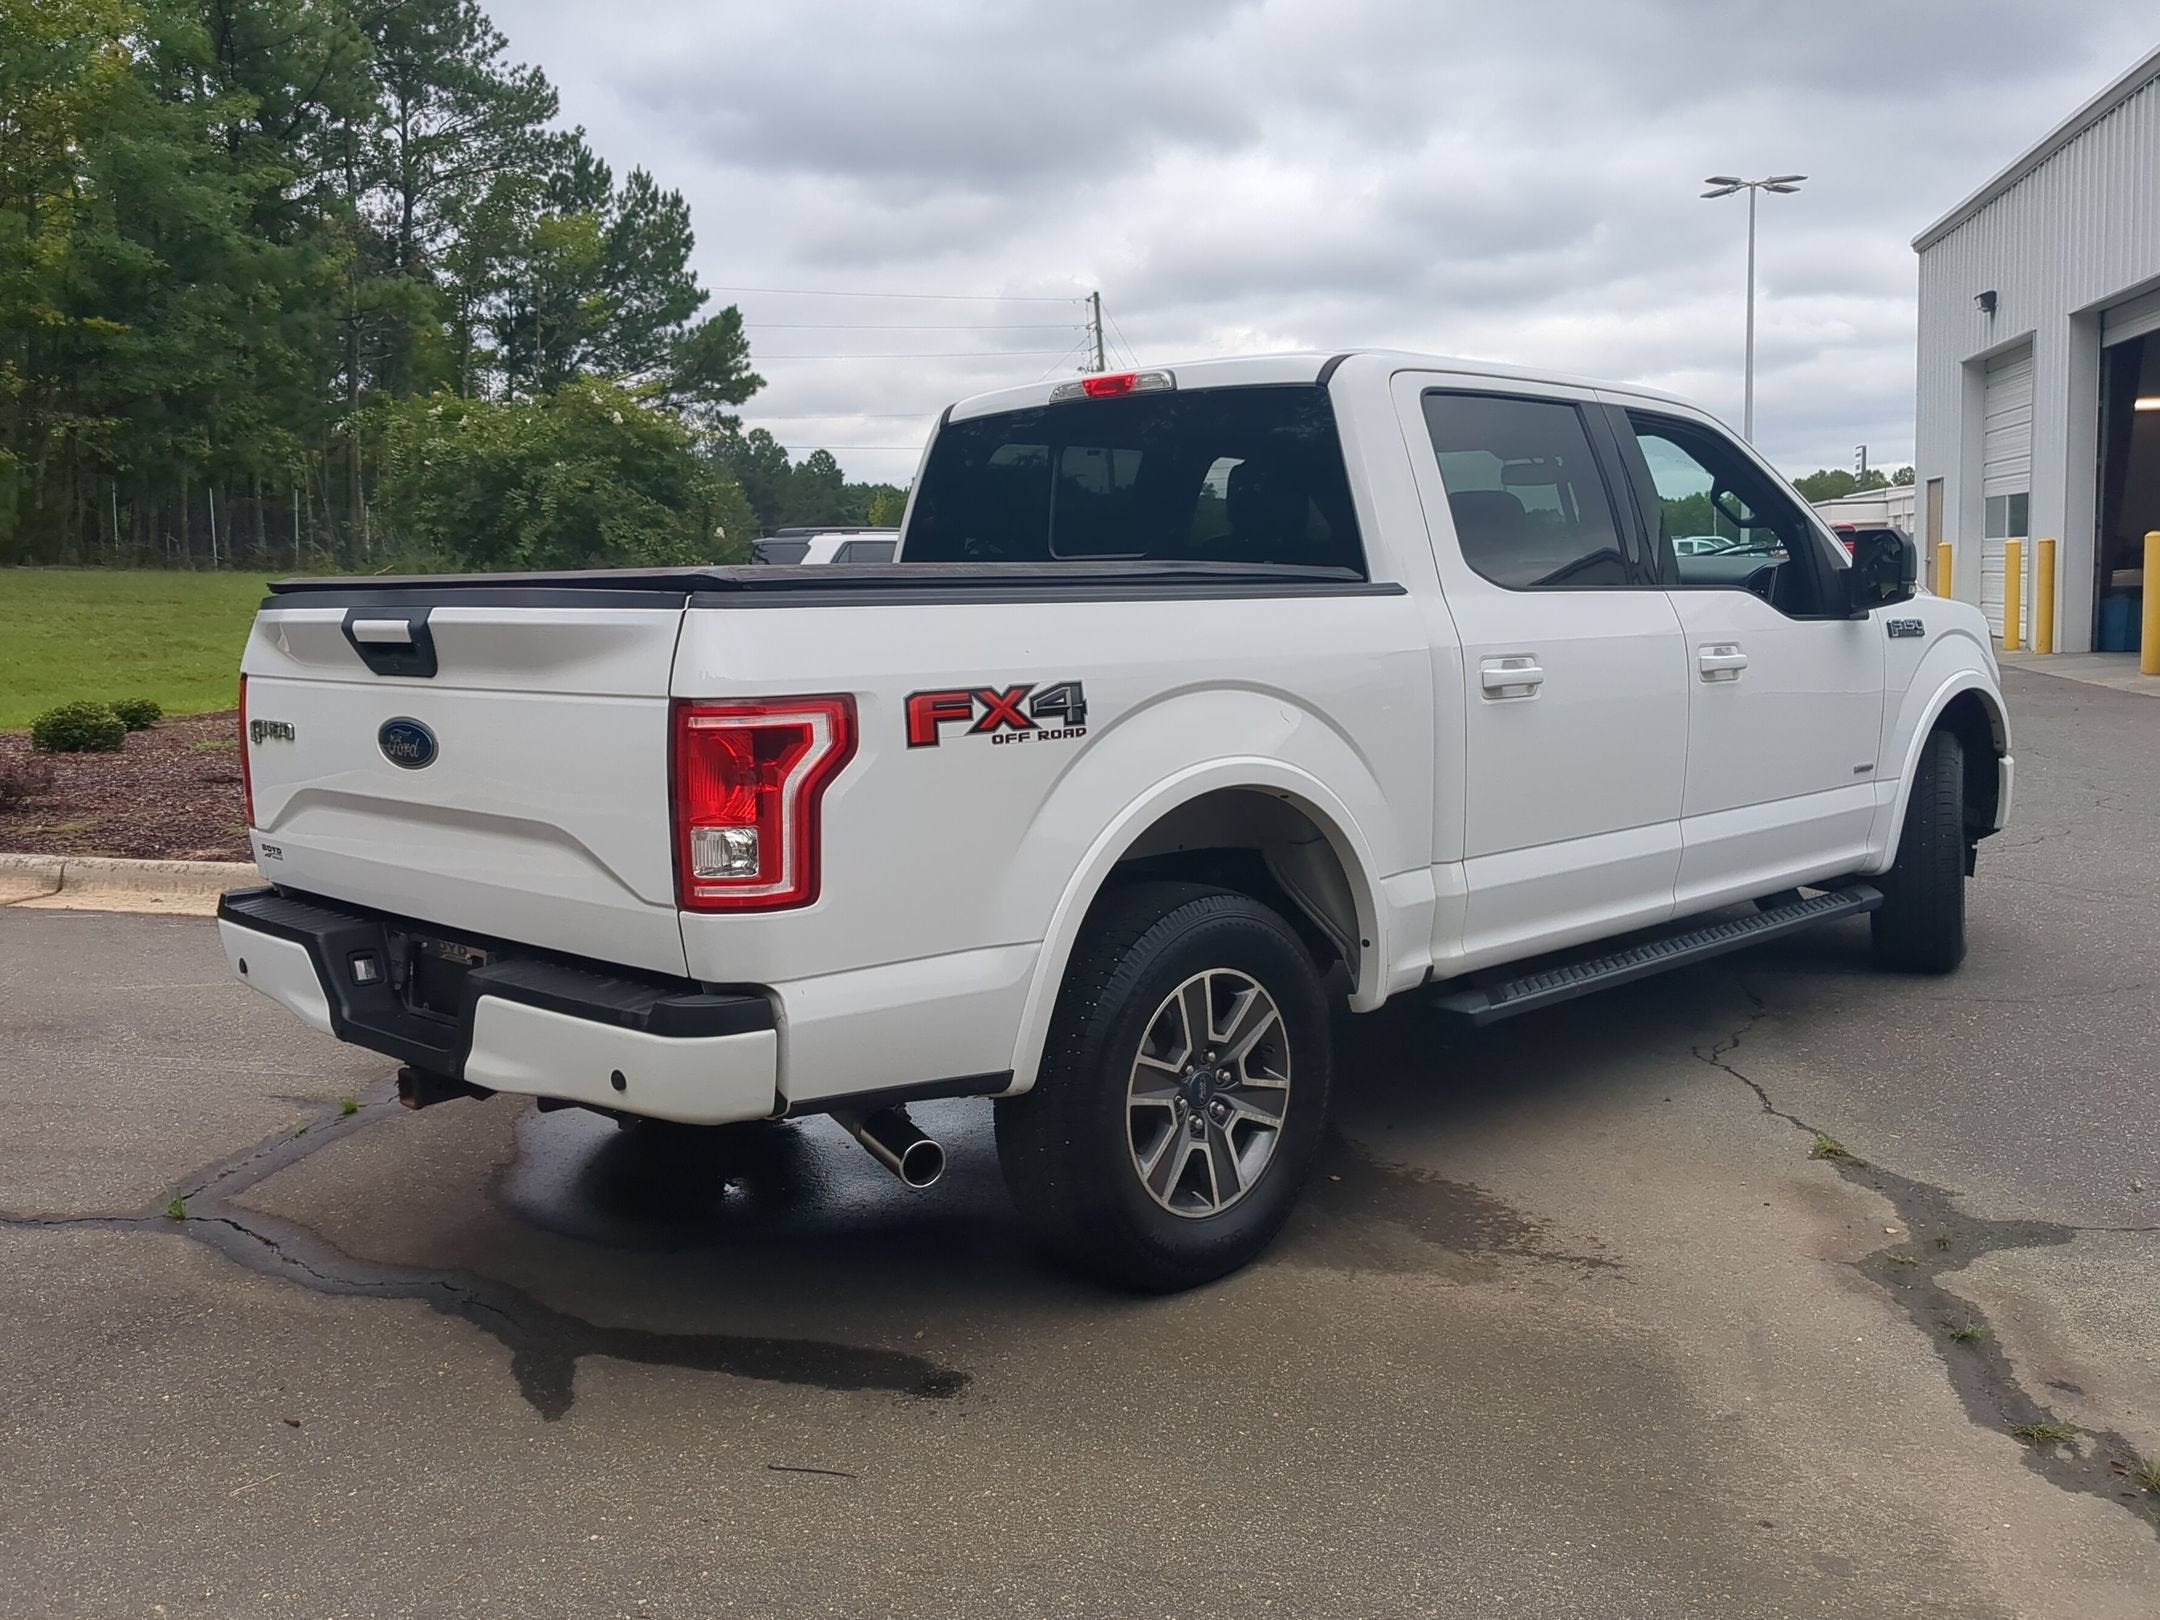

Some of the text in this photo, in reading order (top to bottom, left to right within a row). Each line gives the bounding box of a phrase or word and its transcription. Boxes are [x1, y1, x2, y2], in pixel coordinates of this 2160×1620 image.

[903, 680, 1088, 750] FX4
[388, 728, 421, 758] Ford
[991, 727, 1087, 745] OFF ROAD
